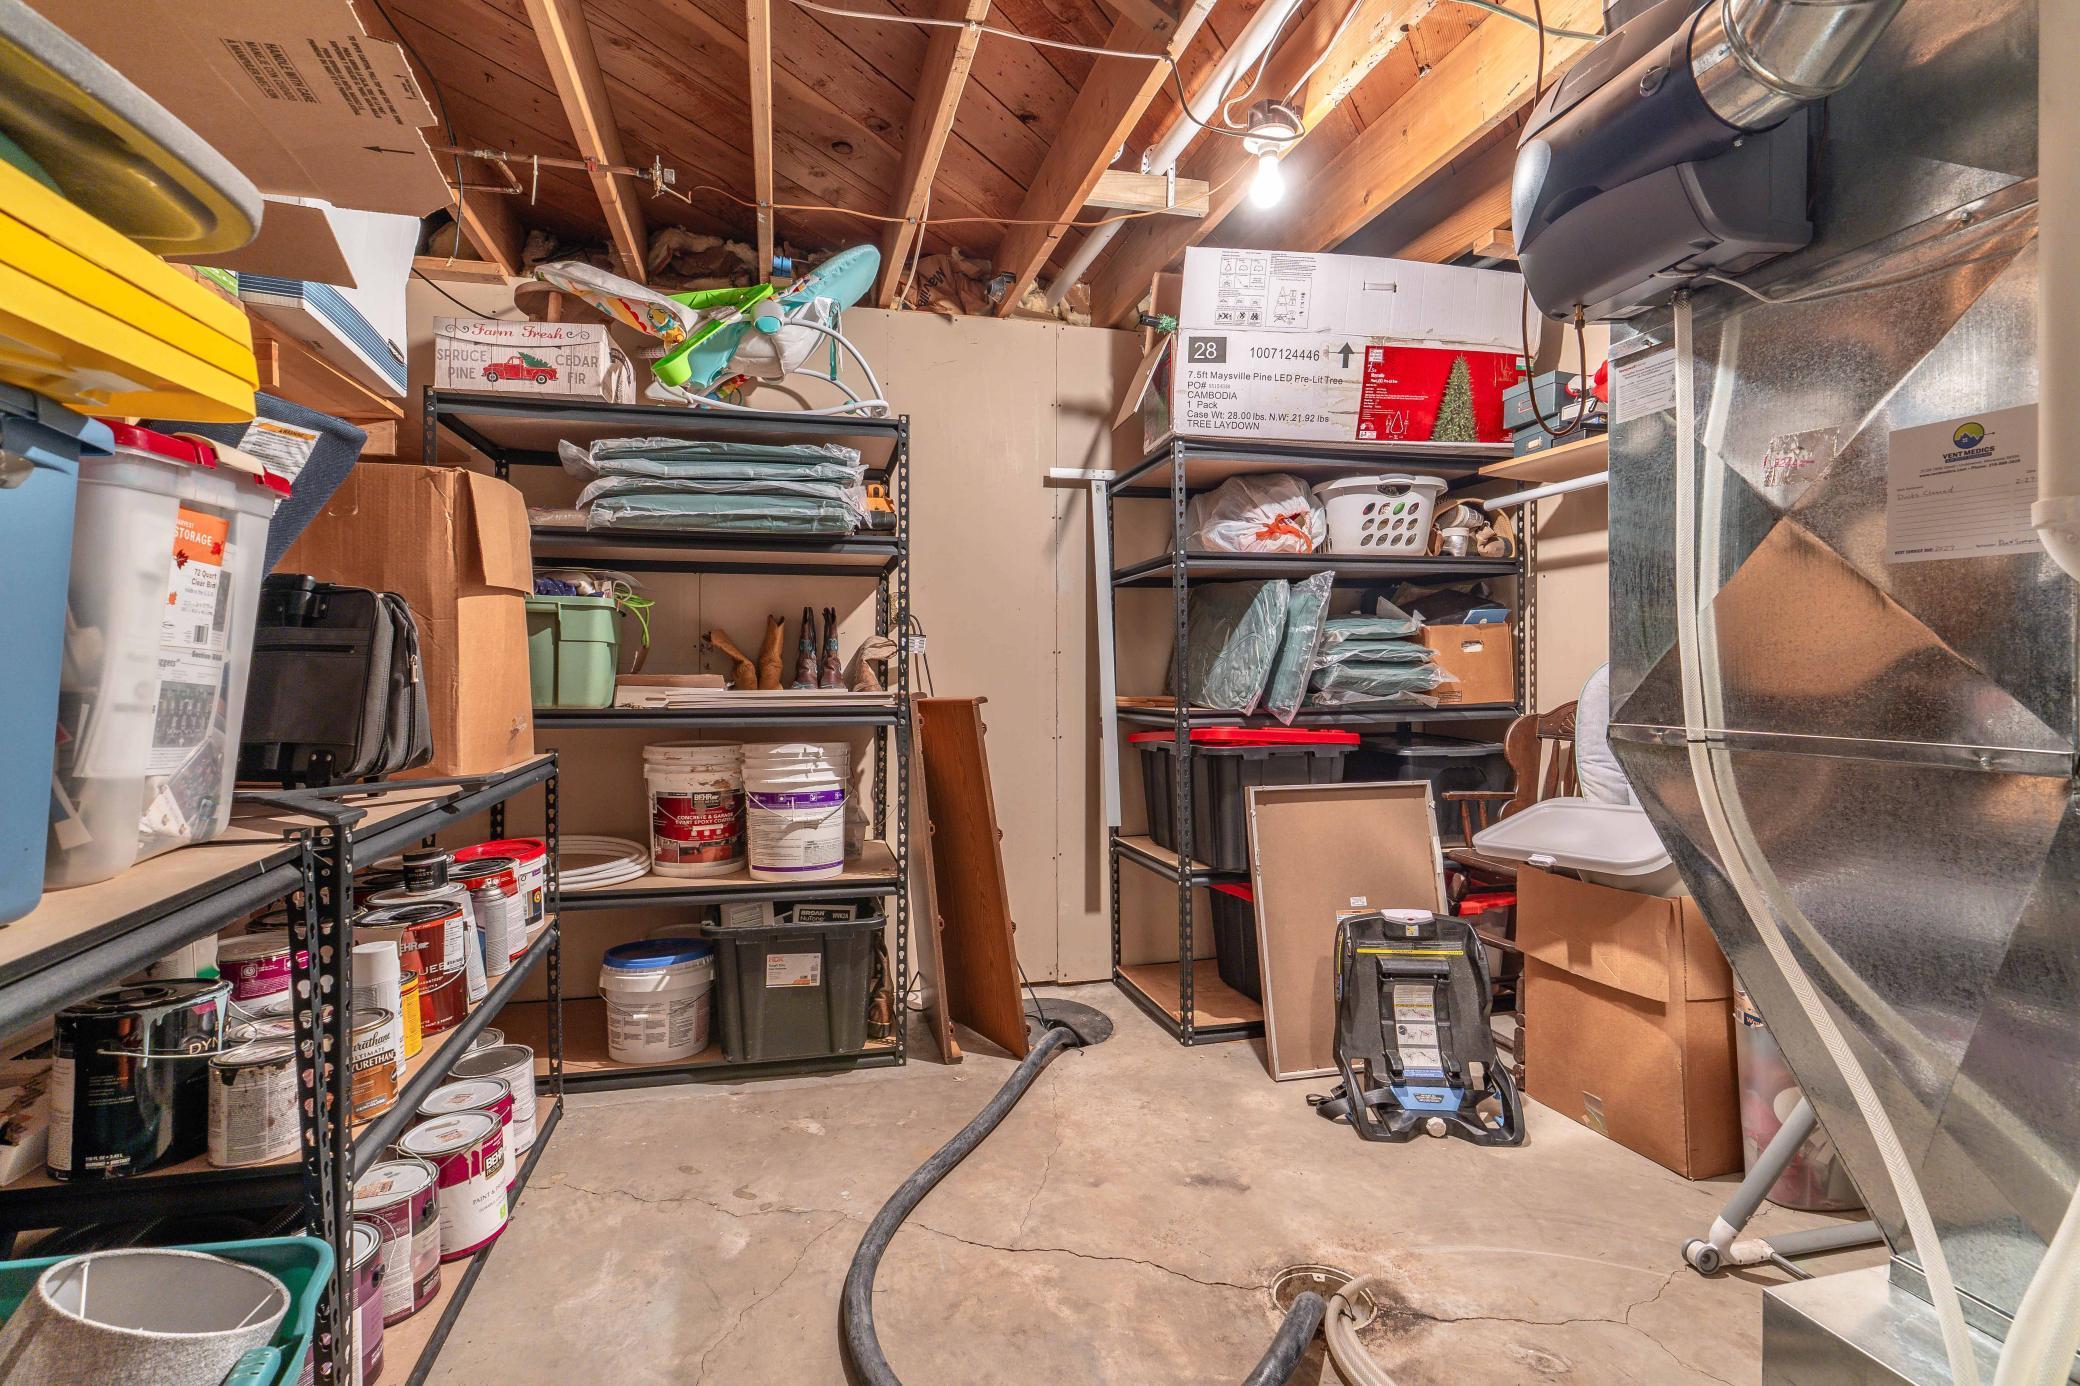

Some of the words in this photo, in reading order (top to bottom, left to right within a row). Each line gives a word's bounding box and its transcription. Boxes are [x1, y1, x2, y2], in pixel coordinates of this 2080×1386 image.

[263, 43, 294, 71] HANDLE
[284, 71, 306, 88] WITH
[296, 87, 318, 104] CARE
[471, 323, 513, 337] Farm
[522, 325, 564, 340] Fresh
[437, 348, 487, 362] SPRUCE
[1193, 342, 1218, 359] 28
[1250, 346, 1320, 362] 1007124446
[555, 354, 599, 368] CEDAR
[448, 366, 476, 379] PINE
[567, 372, 586, 385] FIR
[1188, 370, 1208, 379] 7.5ft
[1210, 371, 1251, 382] Maysville
[1253, 372, 1272, 381] Pine
[1274, 373, 1292, 382] LED
[1294, 374, 1323, 384] Pre-Lit
[1325, 376, 1344, 385] Tree
[1187, 381, 1207, 390] PO#
[1187, 391, 1238, 400] CAMBODIA
[1196, 400, 1218, 409] Pack
[1186, 410, 1209, 419] Case
[1211, 411, 1226, 419] Wt:
[1227, 411, 1251, 420] 28.00
[1317, 414, 1330, 423] lbs
[1187, 420, 1212, 429] TREE
[1214, 421, 1261, 430] LAYDOWN
[1942, 451, 1963, 460] VENT
[1963, 445, 1995, 456] MEDICS
[194, 568, 201, 577] 72
[201, 570, 217, 580] Quart
[191, 578, 206, 588] Clear
[693, 793, 712, 801] BEHR
[400, 941, 419, 953] EHR
[352, 1046, 385, 1061] LTIMATE
